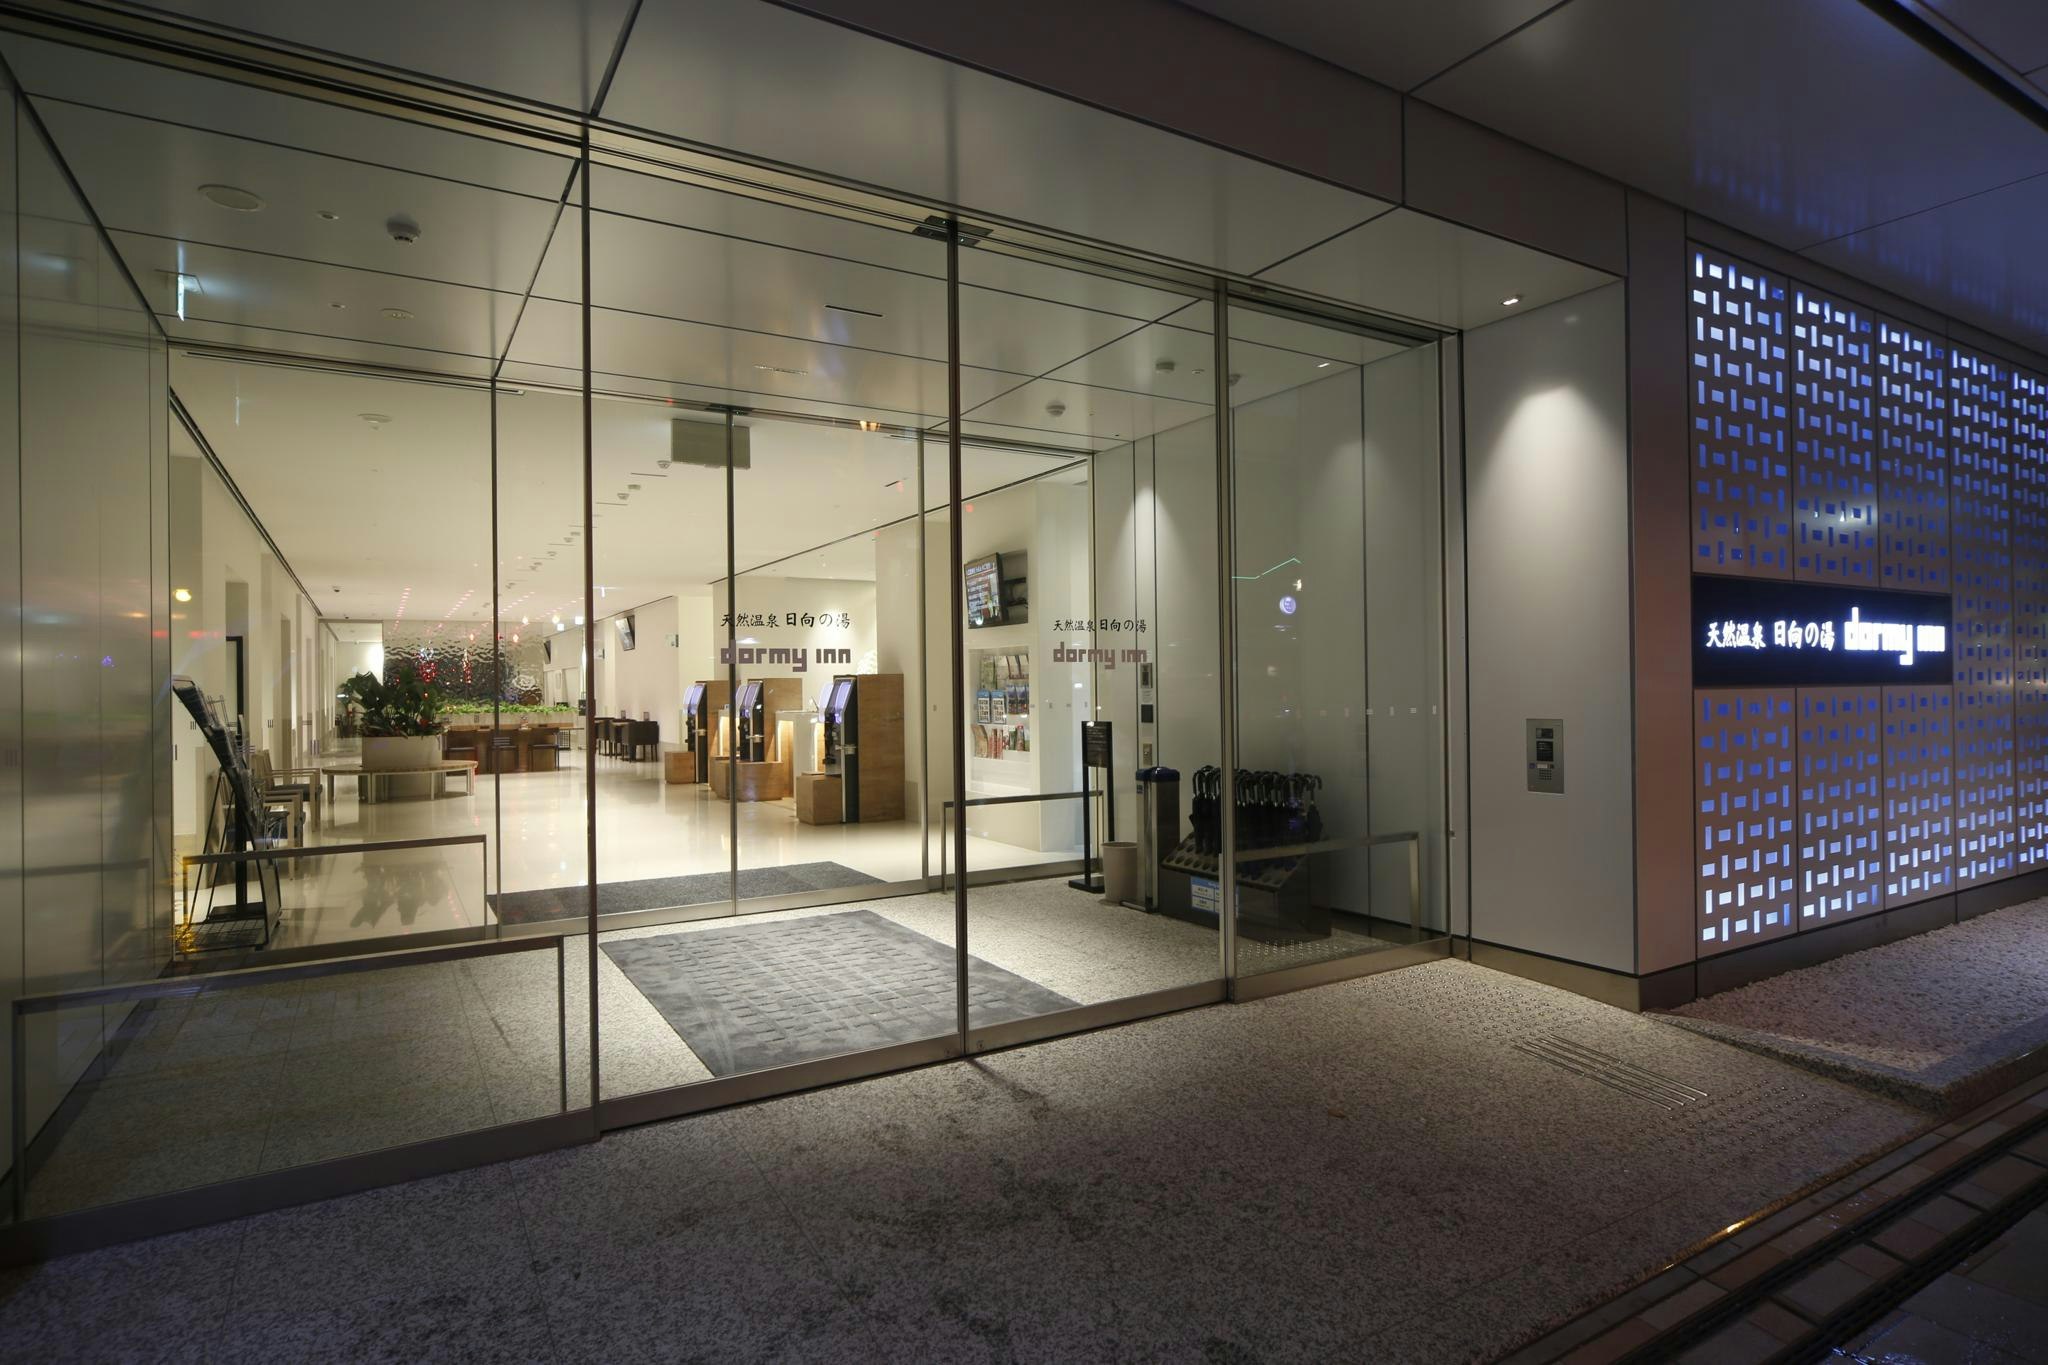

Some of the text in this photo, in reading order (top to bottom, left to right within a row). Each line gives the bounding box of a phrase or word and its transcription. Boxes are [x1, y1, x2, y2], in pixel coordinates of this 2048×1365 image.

[720, 612, 850, 629] 天然温泉 日向の湯
[1053, 618, 1147, 633] 天然温泉 日向の湯
[1706, 620, 1766, 650] 天然温泉
[1774, 620, 1835, 651] 日向の湯
[1844, 607, 1913, 665] dormy
[720, 640, 851, 672] dormy inn
[1053, 641, 1147, 670] dormy inn
